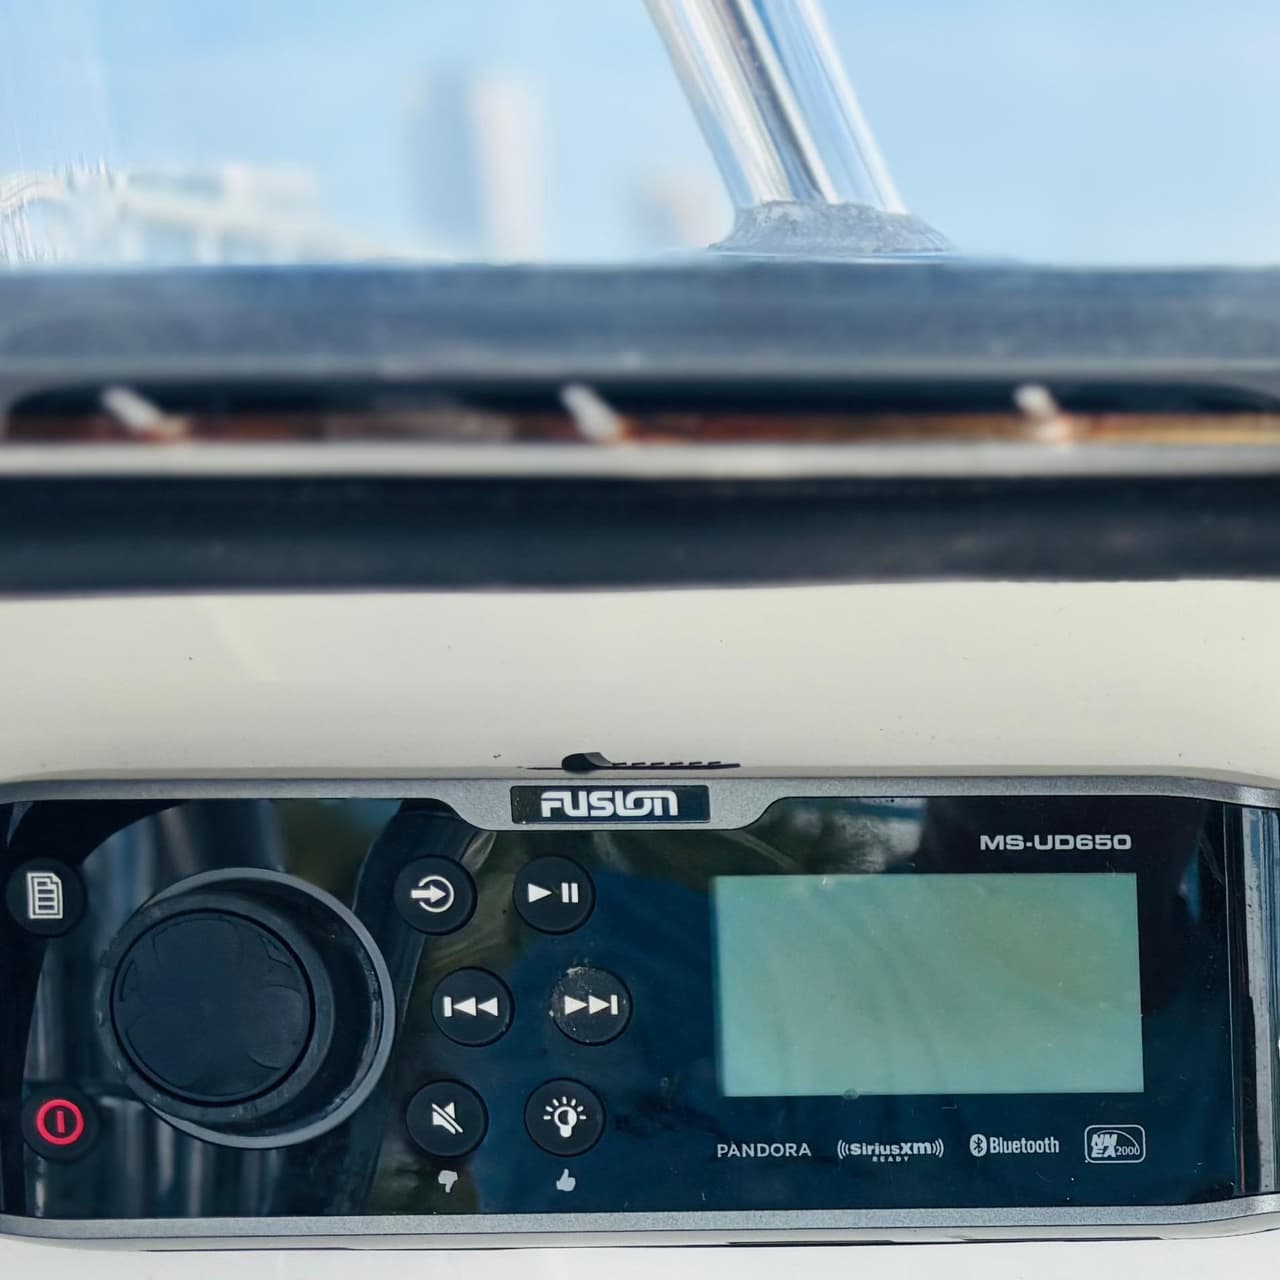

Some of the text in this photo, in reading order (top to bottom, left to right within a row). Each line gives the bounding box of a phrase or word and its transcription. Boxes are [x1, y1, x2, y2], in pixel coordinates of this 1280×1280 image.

[540, 790, 679, 817] FUSION
[980, 834, 1132, 850] MS-UD650
[717, 1143, 812, 1158] PANDORA
[989, 1136, 1060, 1154] Bluetooth
[1115, 1145, 1141, 1156] 2000
